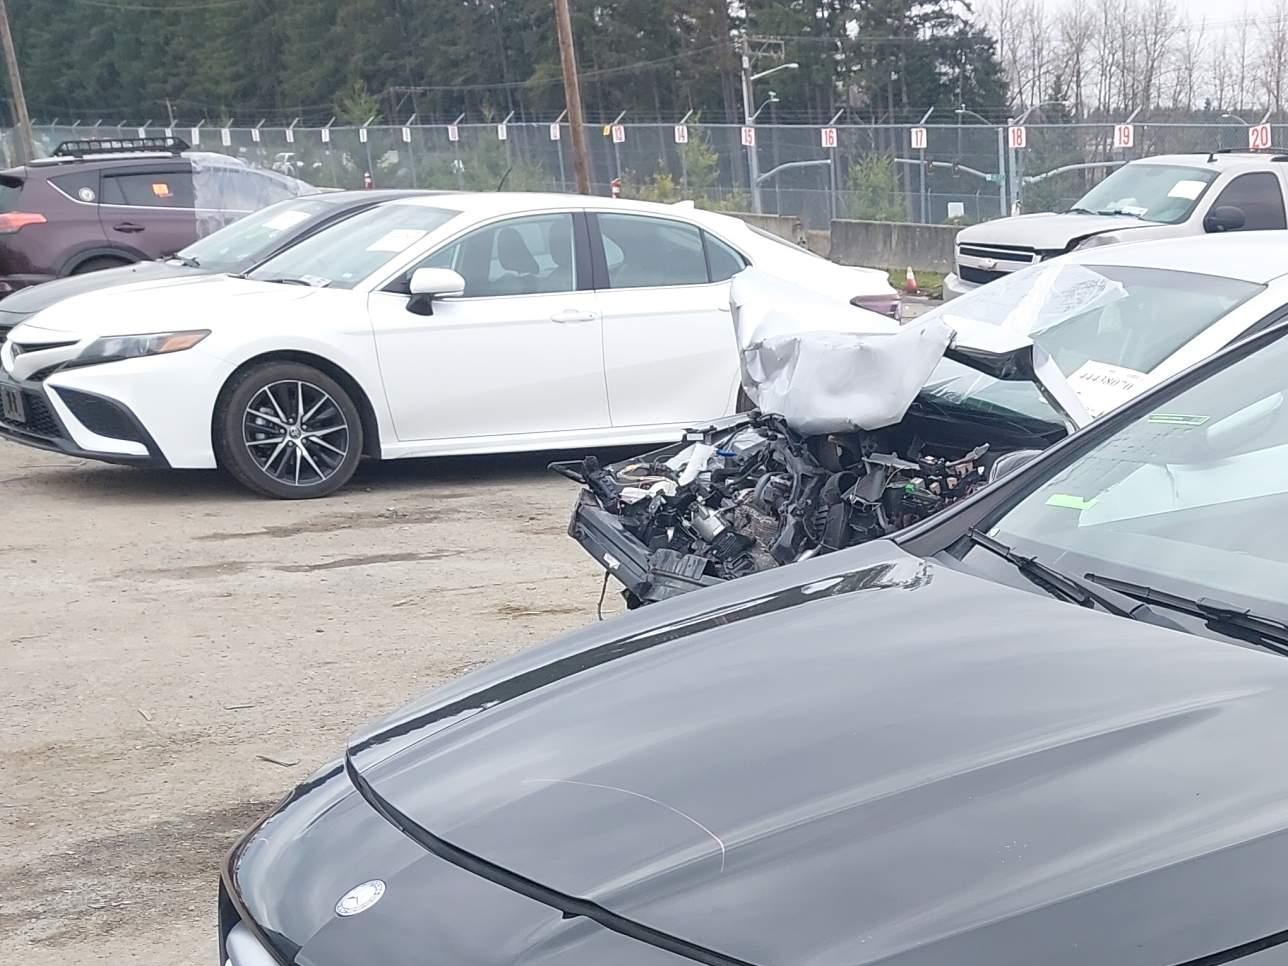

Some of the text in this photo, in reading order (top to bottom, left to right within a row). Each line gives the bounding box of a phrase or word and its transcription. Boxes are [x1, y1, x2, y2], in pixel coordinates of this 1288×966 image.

[743, 128, 753, 145] 15
[824, 129, 835, 146] 16
[914, 129, 924, 147] 17
[1011, 128, 1024, 146] 18
[1118, 126, 1131, 146] 19
[1250, 126, 1270, 148] 20
